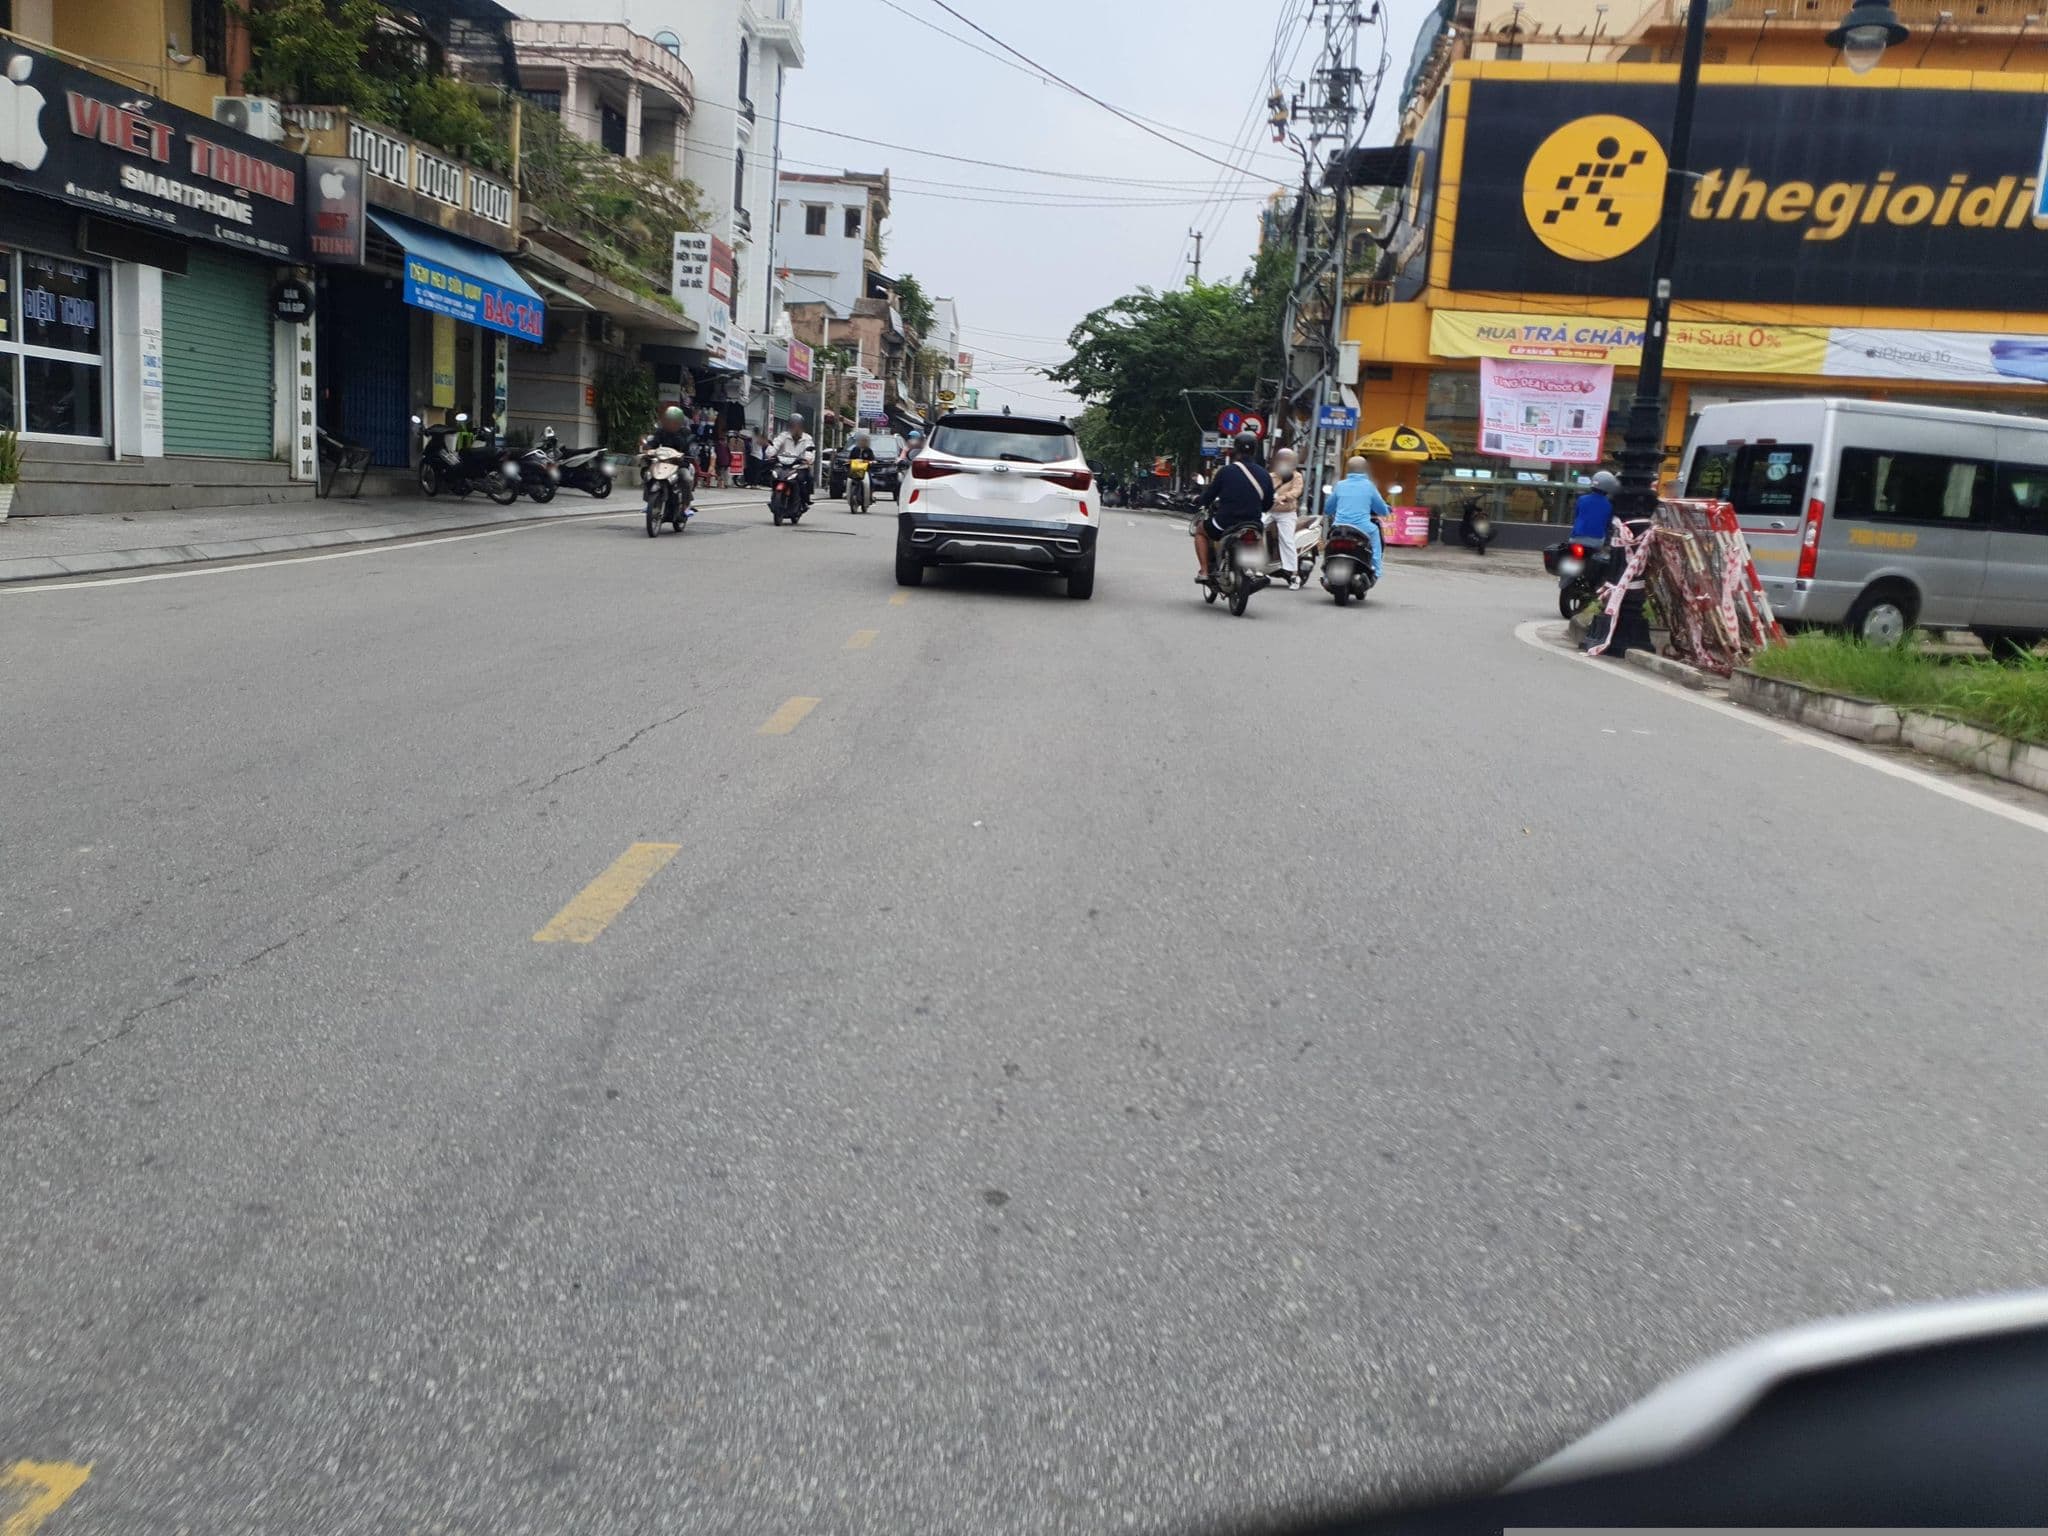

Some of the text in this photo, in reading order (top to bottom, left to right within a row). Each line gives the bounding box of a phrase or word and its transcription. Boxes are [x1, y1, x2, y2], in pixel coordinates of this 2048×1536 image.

[185, 133, 296, 205] THỊNH
[119, 163, 254, 226] SMARTPHONE
[1689, 167, 2047, 241] thegioidi
[24, 284, 96, 335] ĐIỆN THOẠI
[1476, 322, 1646, 350] MUA TRẢ CHẬM
[1697, 328, 1743, 347] Suất
[1749, 327, 1781, 348] 0%
[1879, 346, 1952, 363] iPhone 16
[300, 384, 312, 401] LÊN
